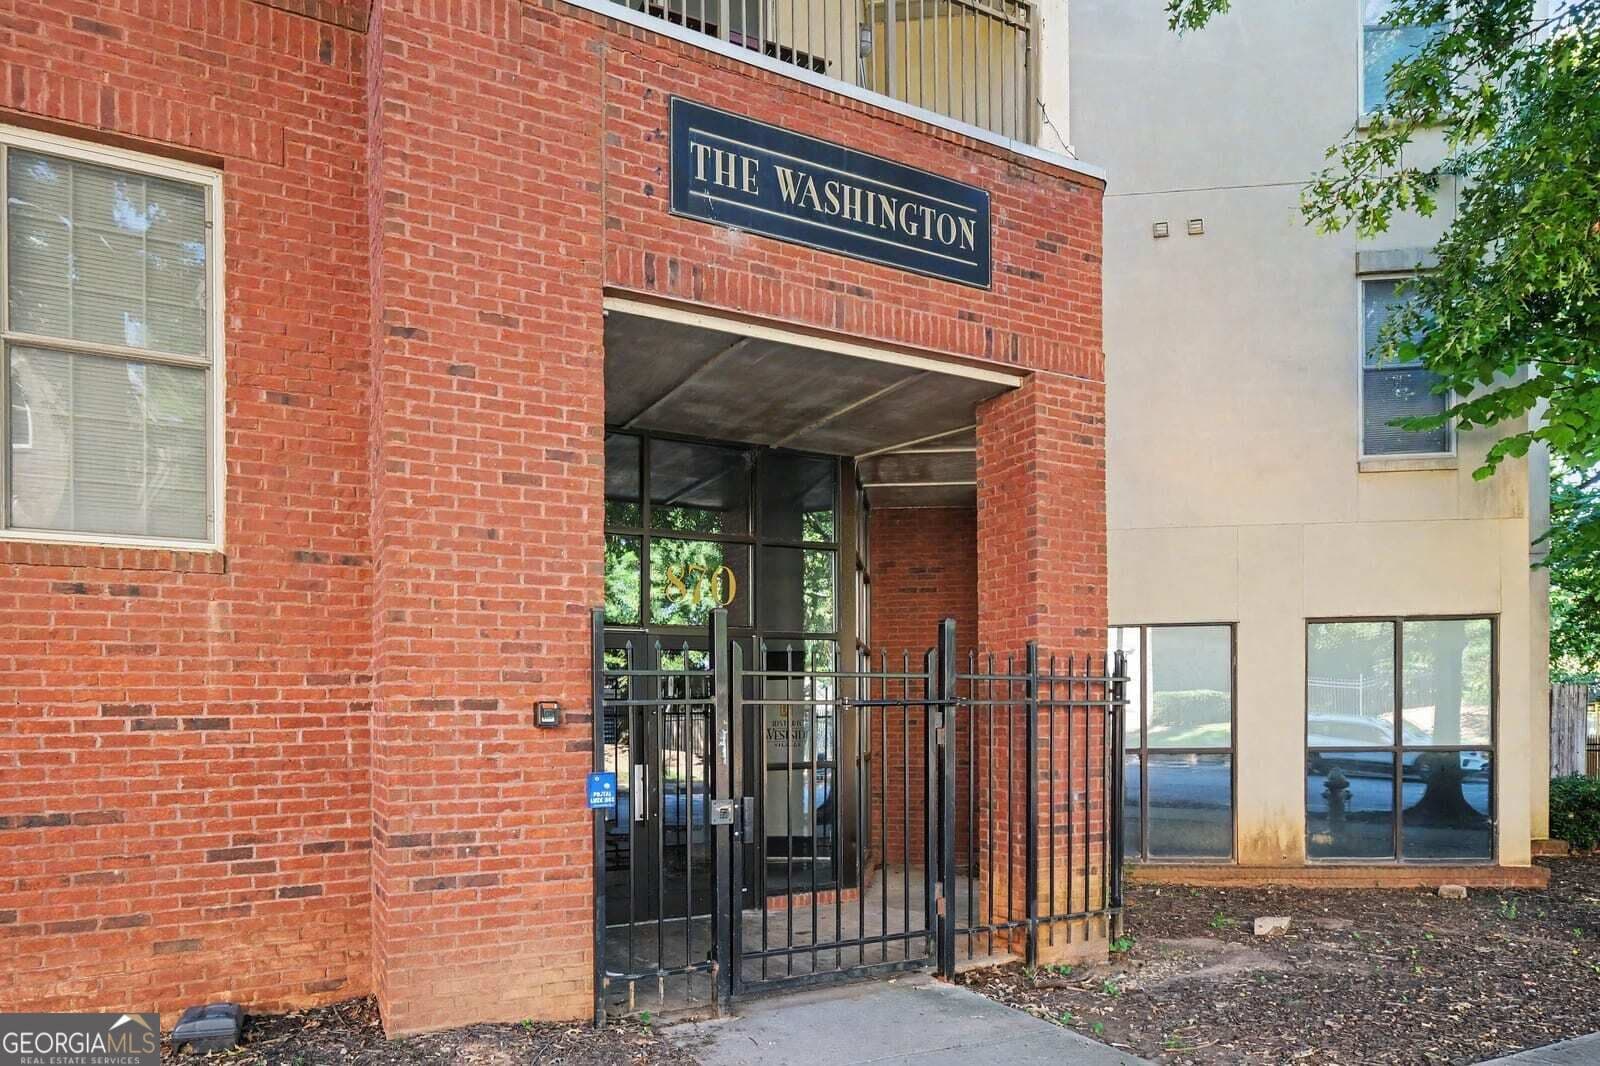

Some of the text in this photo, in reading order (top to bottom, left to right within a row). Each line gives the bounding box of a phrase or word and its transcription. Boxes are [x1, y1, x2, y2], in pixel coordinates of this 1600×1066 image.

[690, 141, 977, 252] THE WASHINGTON
[666, 564, 737, 606] 870
